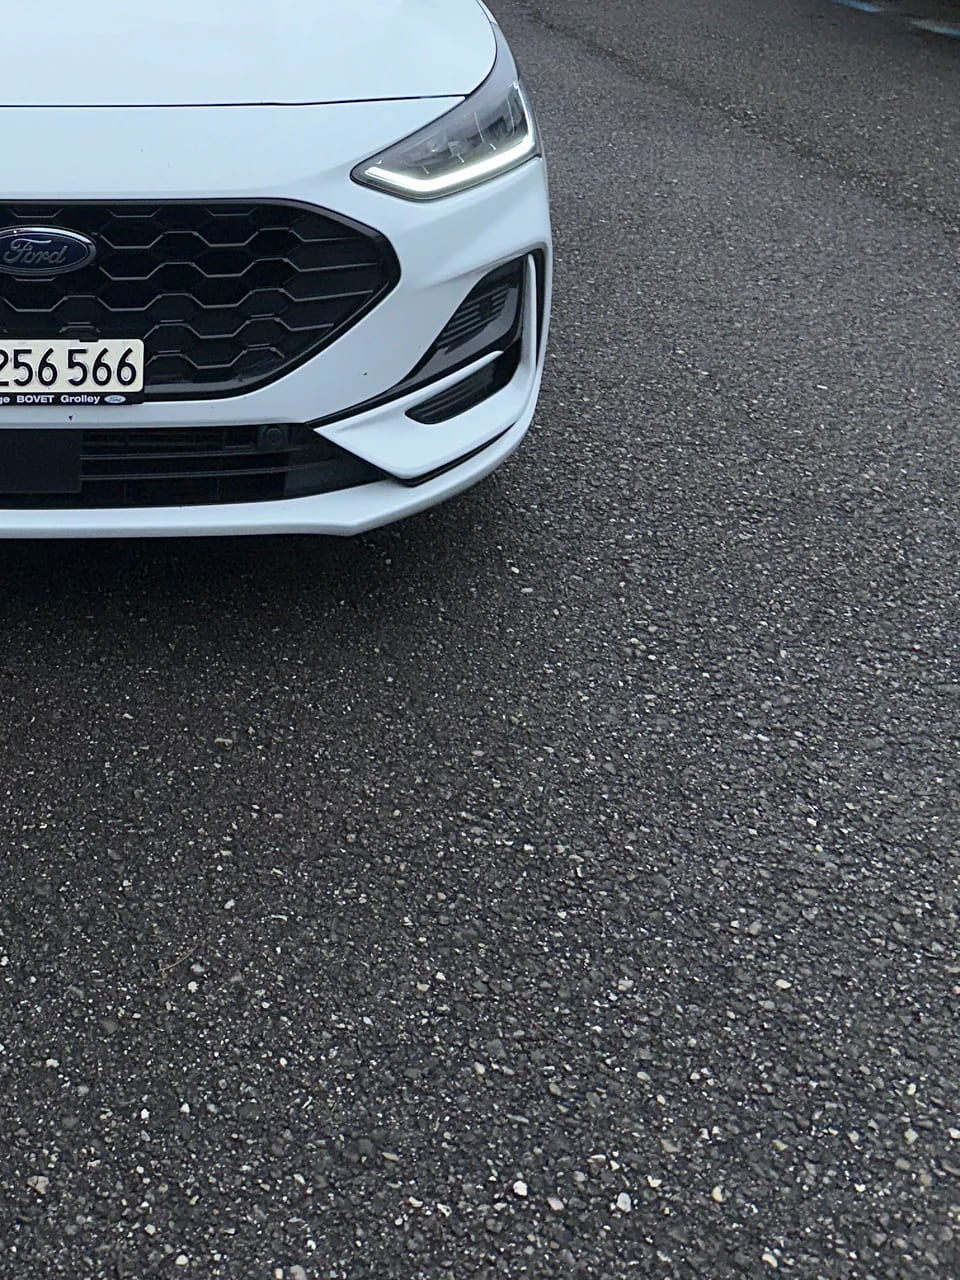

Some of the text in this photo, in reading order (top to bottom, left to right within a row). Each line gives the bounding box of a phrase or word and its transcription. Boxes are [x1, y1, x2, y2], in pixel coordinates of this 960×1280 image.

[3, 238, 69, 265] Ford
[16, 395, 55, 403] BOVET
[60, 395, 101, 404] Grolley
